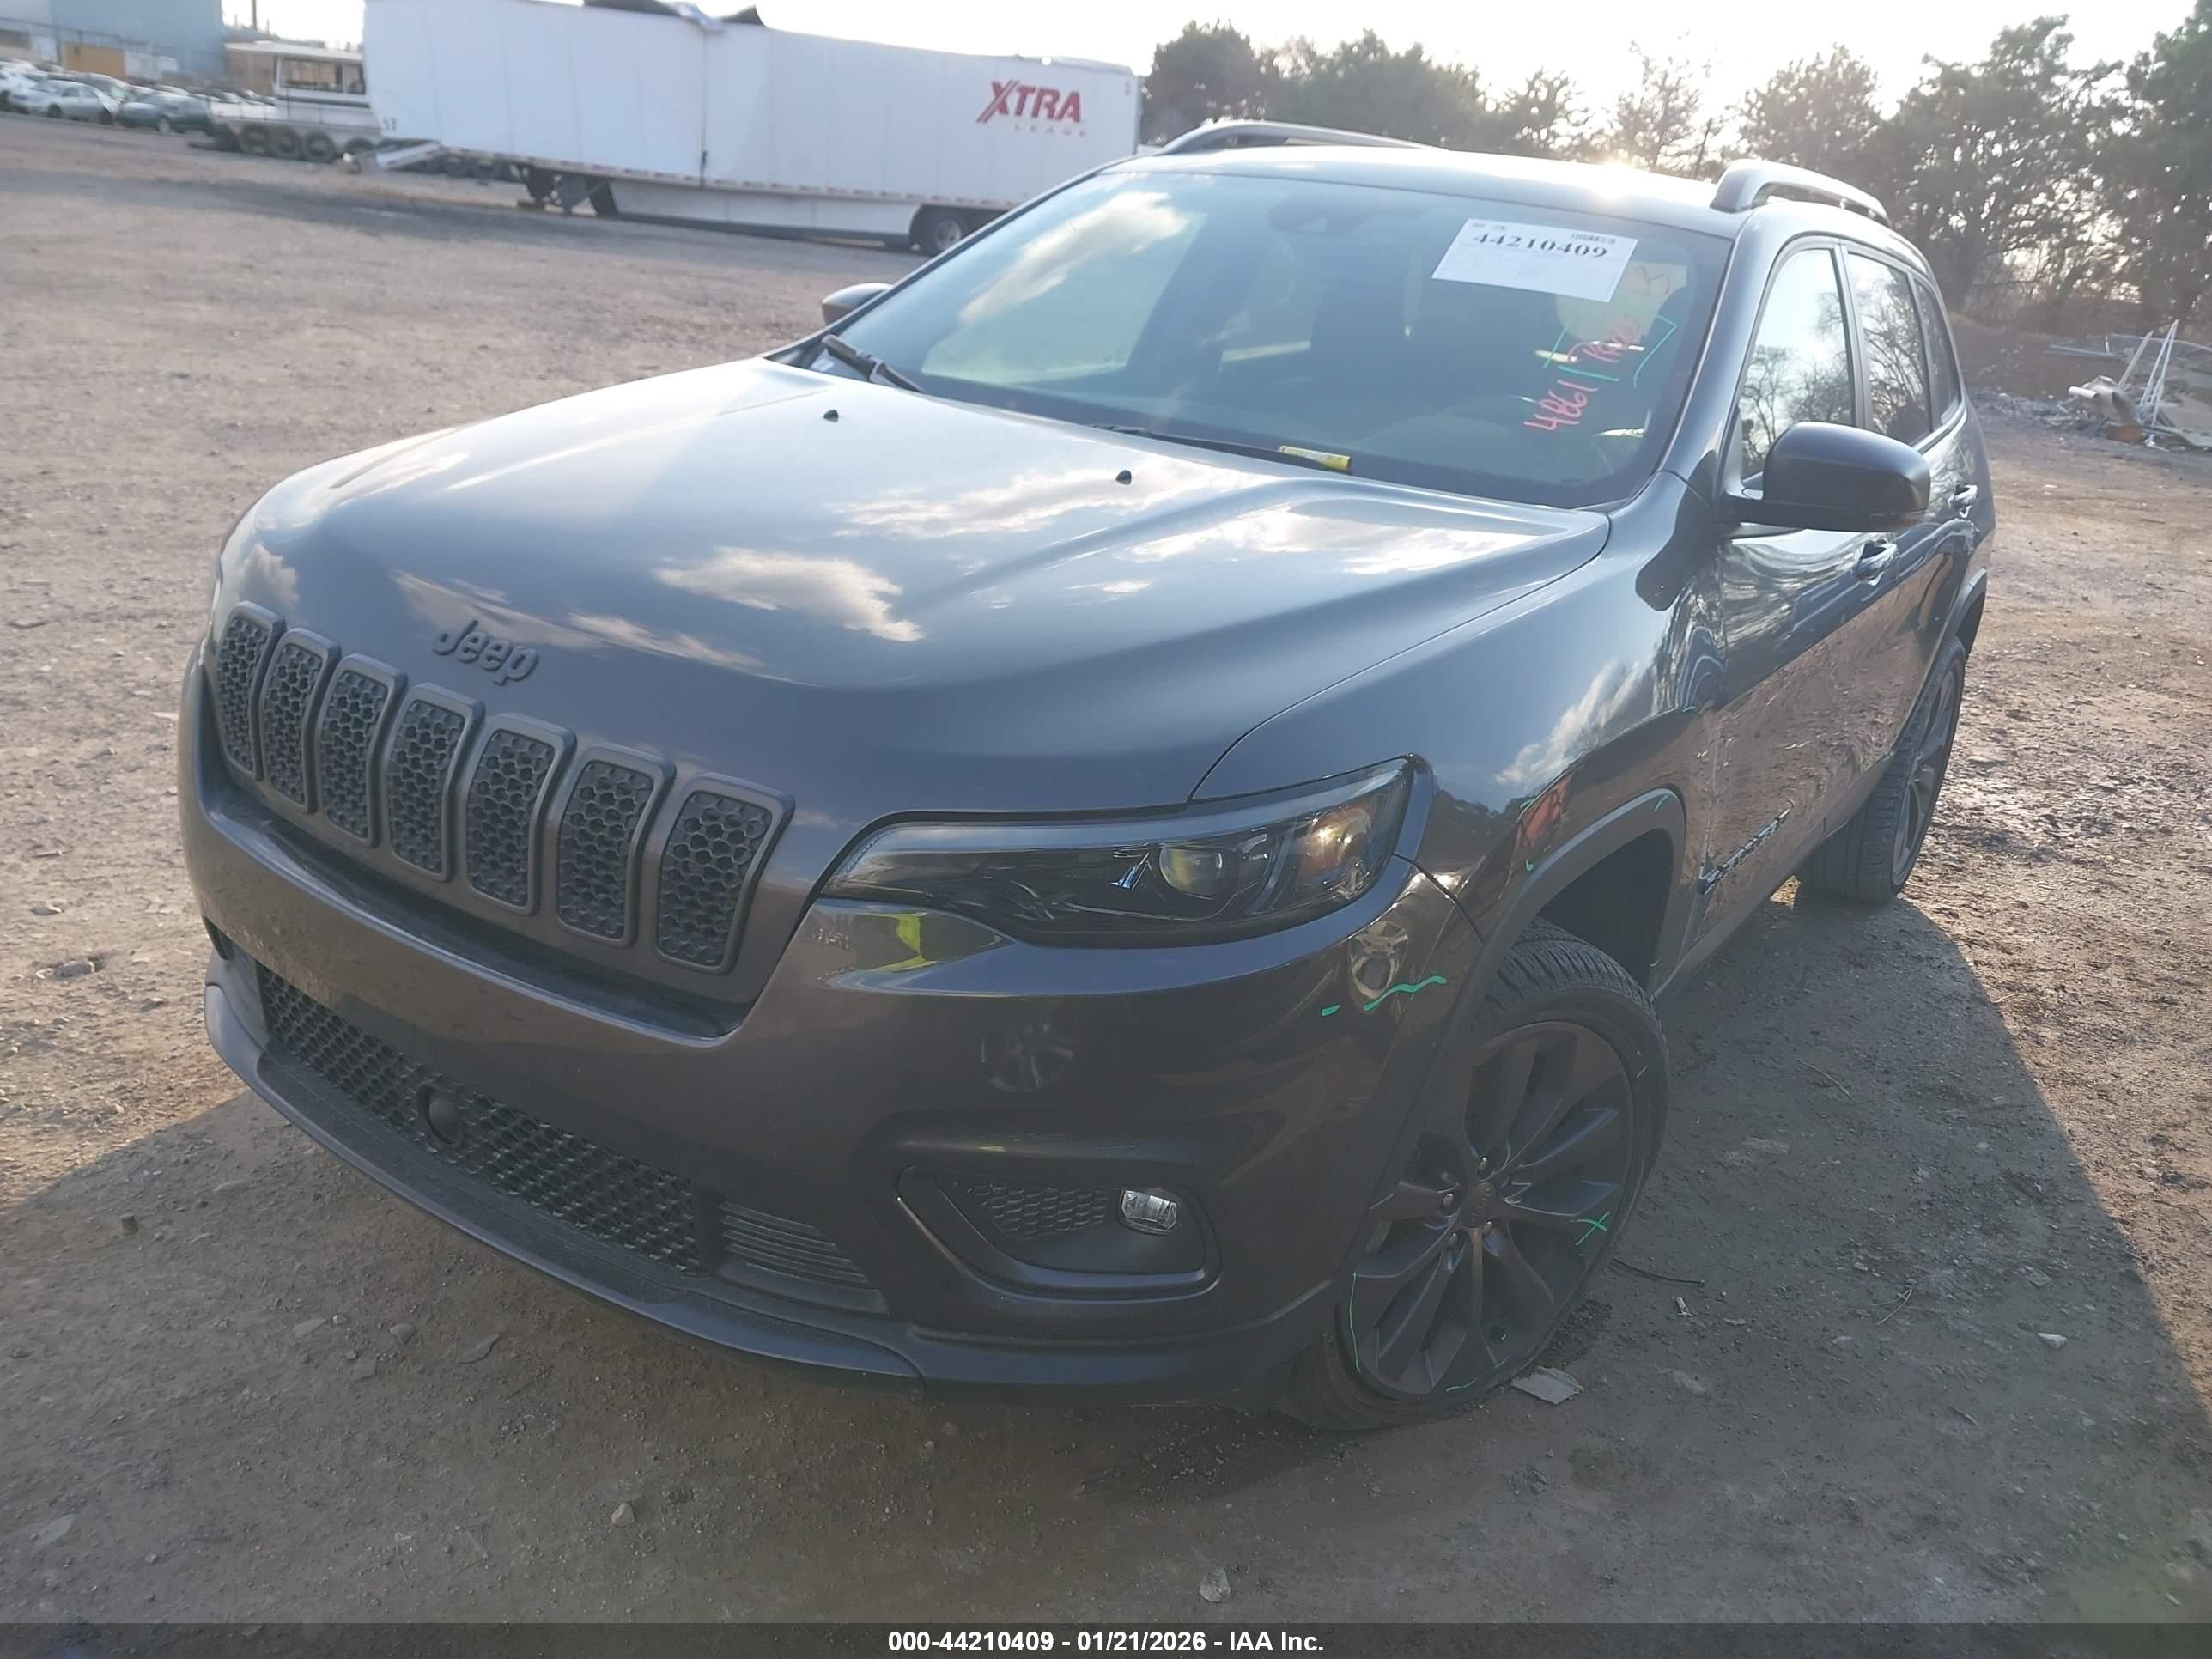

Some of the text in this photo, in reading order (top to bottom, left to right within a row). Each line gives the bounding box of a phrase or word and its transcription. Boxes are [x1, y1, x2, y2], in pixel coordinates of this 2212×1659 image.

[976, 79, 1081, 123] XTRA
[1472, 233, 1608, 258] 44210409
[431, 618, 540, 686] Jeep
